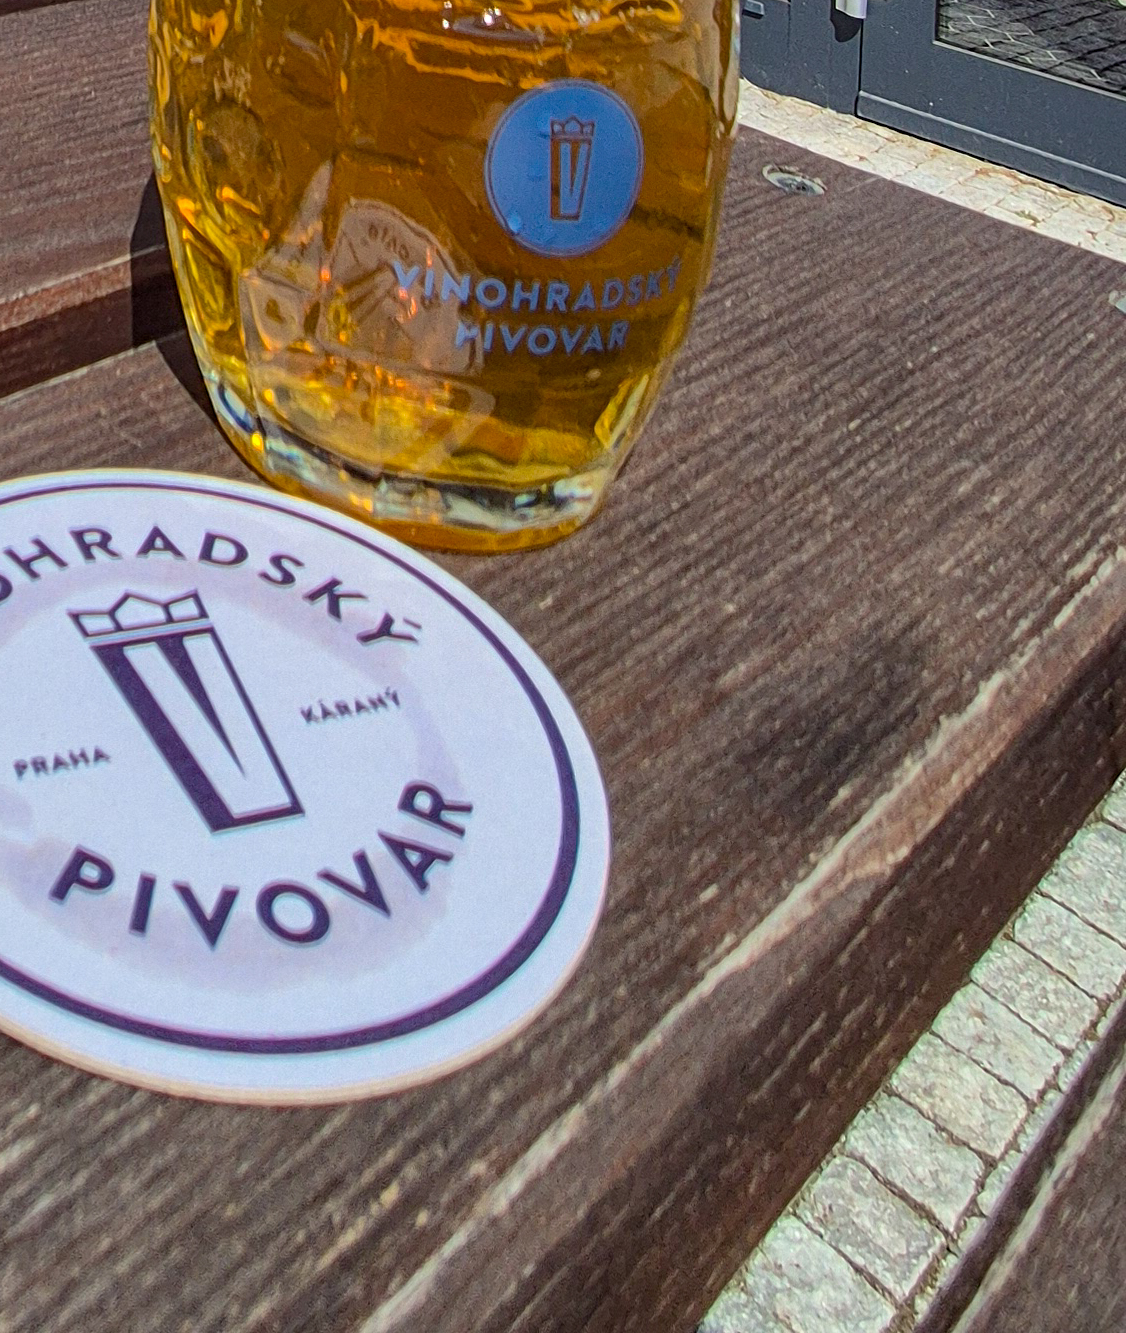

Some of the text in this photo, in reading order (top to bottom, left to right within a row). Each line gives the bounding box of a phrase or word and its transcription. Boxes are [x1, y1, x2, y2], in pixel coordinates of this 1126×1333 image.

[392, 255, 683, 314] VINOHRADSKÝ
[454, 319, 631, 356] PIVOVAR
[12, 746, 112, 780] PRAHA
[47, 780, 475, 951] PIVOVAR
